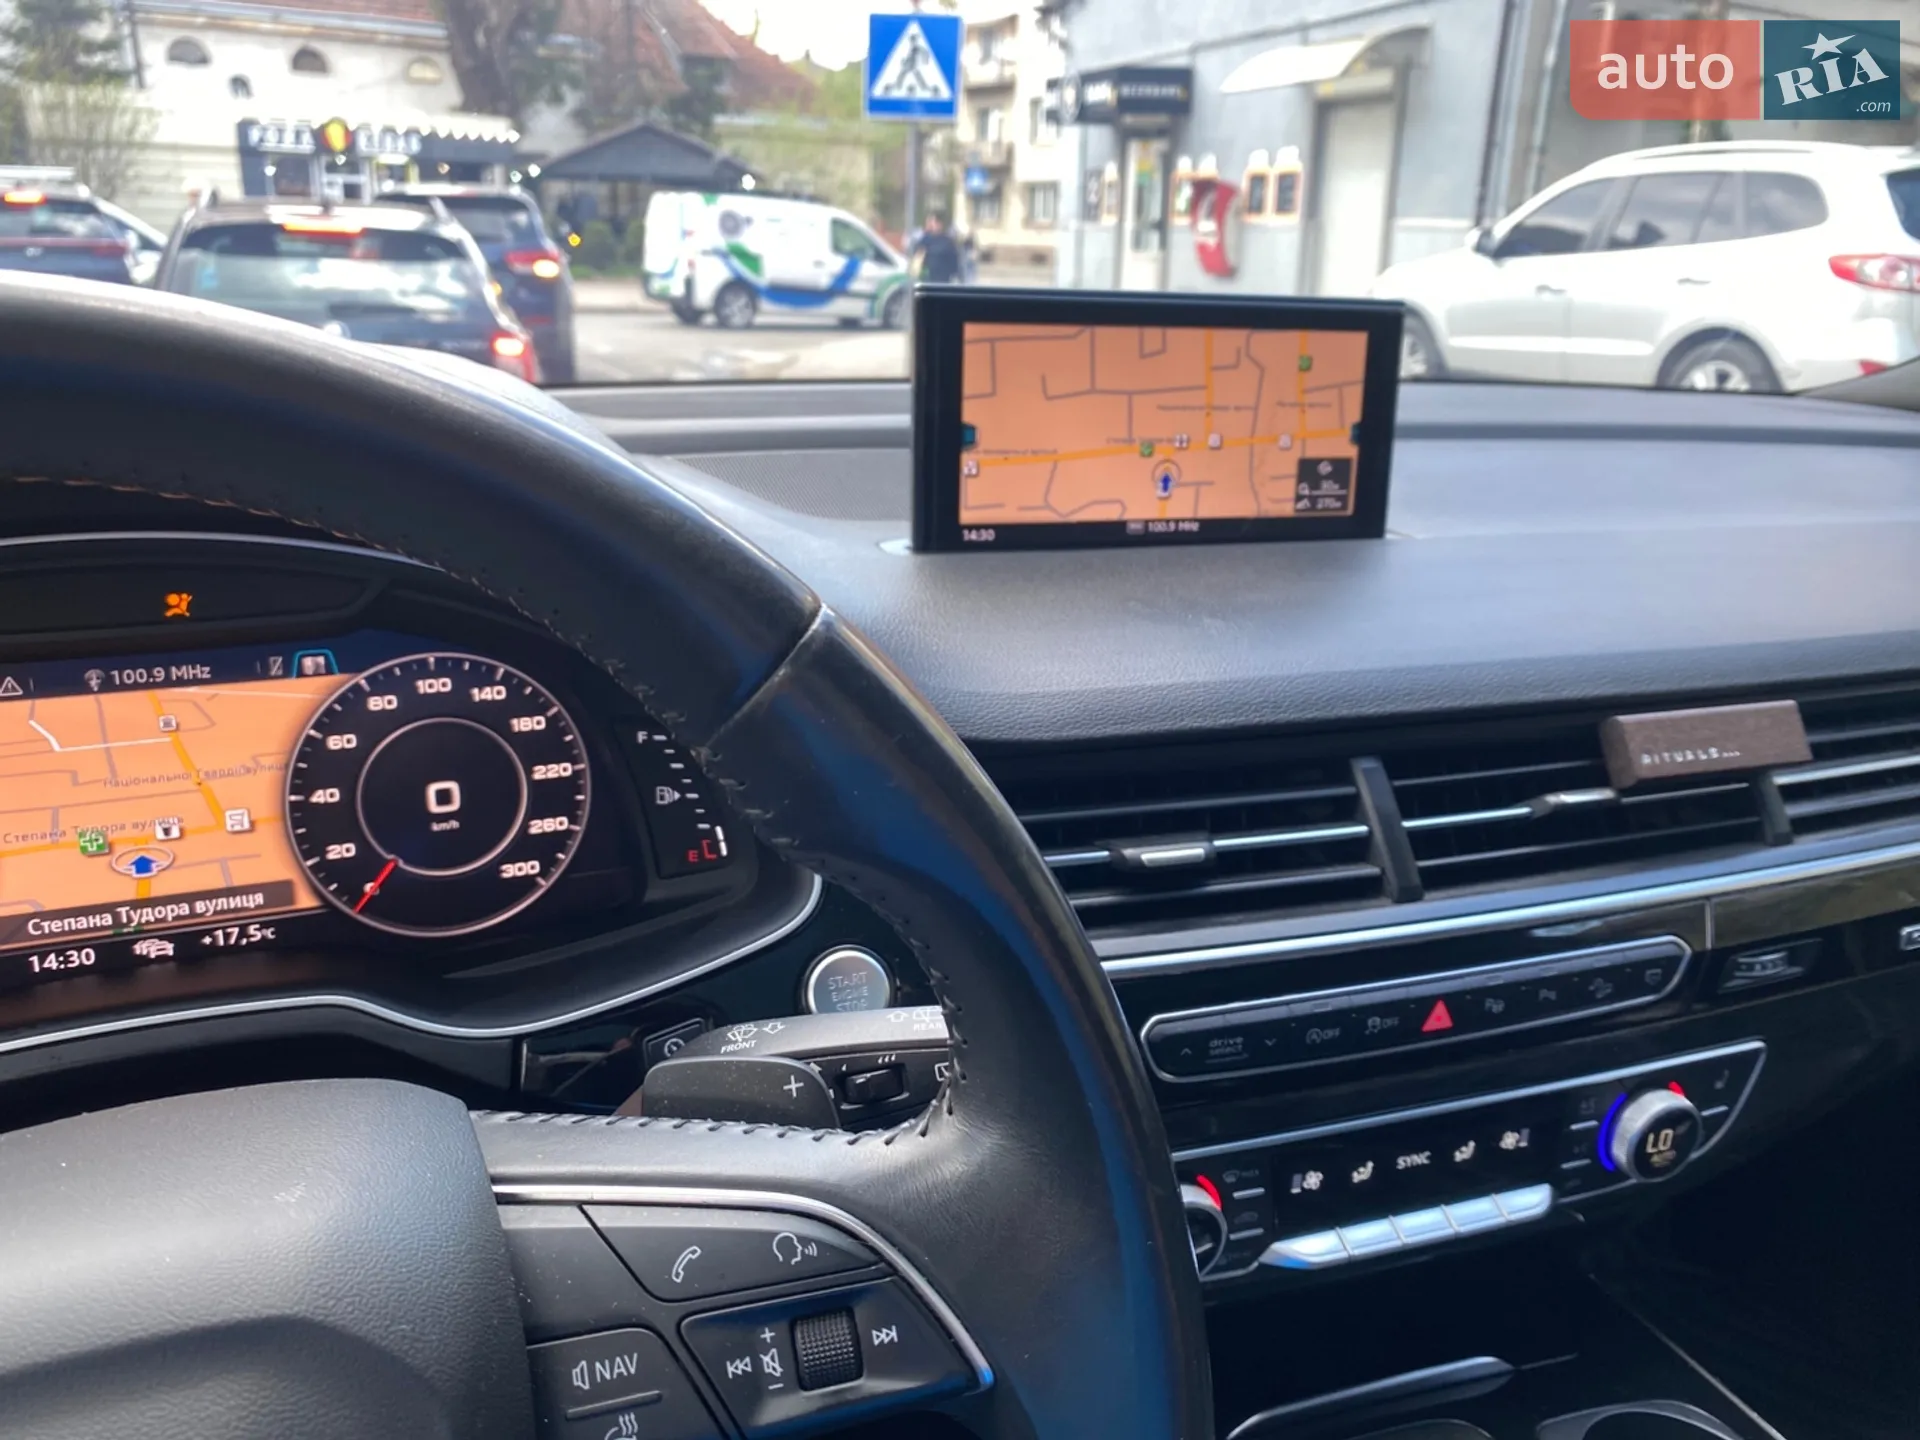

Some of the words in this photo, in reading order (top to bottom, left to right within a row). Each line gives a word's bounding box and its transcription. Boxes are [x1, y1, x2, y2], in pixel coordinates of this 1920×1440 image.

[962, 529, 996, 541] 14:30
[110, 668, 165, 686] 100.9
[171, 663, 212, 680] MHz
[415, 677, 453, 695] 100
[470, 684, 508, 702] 140
[366, 694, 399, 711] 80
[509, 714, 547, 733] 180
[326, 733, 358, 750] 60
[636, 730, 649, 744] F
[530, 760, 572, 780] 220
[309, 787, 341, 804] 40
[425, 780, 461, 814] 0
[430, 820, 460, 832] km/h
[527, 815, 570, 835] 260
[325, 842, 356, 860] 20
[687, 850, 699, 862] E
[499, 860, 541, 879] 300
[27, 914, 113, 936] Степана
[117, 901, 191, 925] Тудора
[195, 890, 265, 914] вулиця
[28, 947, 96, 973] 14:30
[828, 972, 868, 990] START
[720, 1039, 757, 1053] FRONT
[1209, 1036, 1244, 1048] drive
[1209, 1045, 1243, 1056] select
[1646, 1128, 1674, 1153] LO
[1396, 1151, 1430, 1169] SYNC
[595, 1352, 638, 1382] NAV
